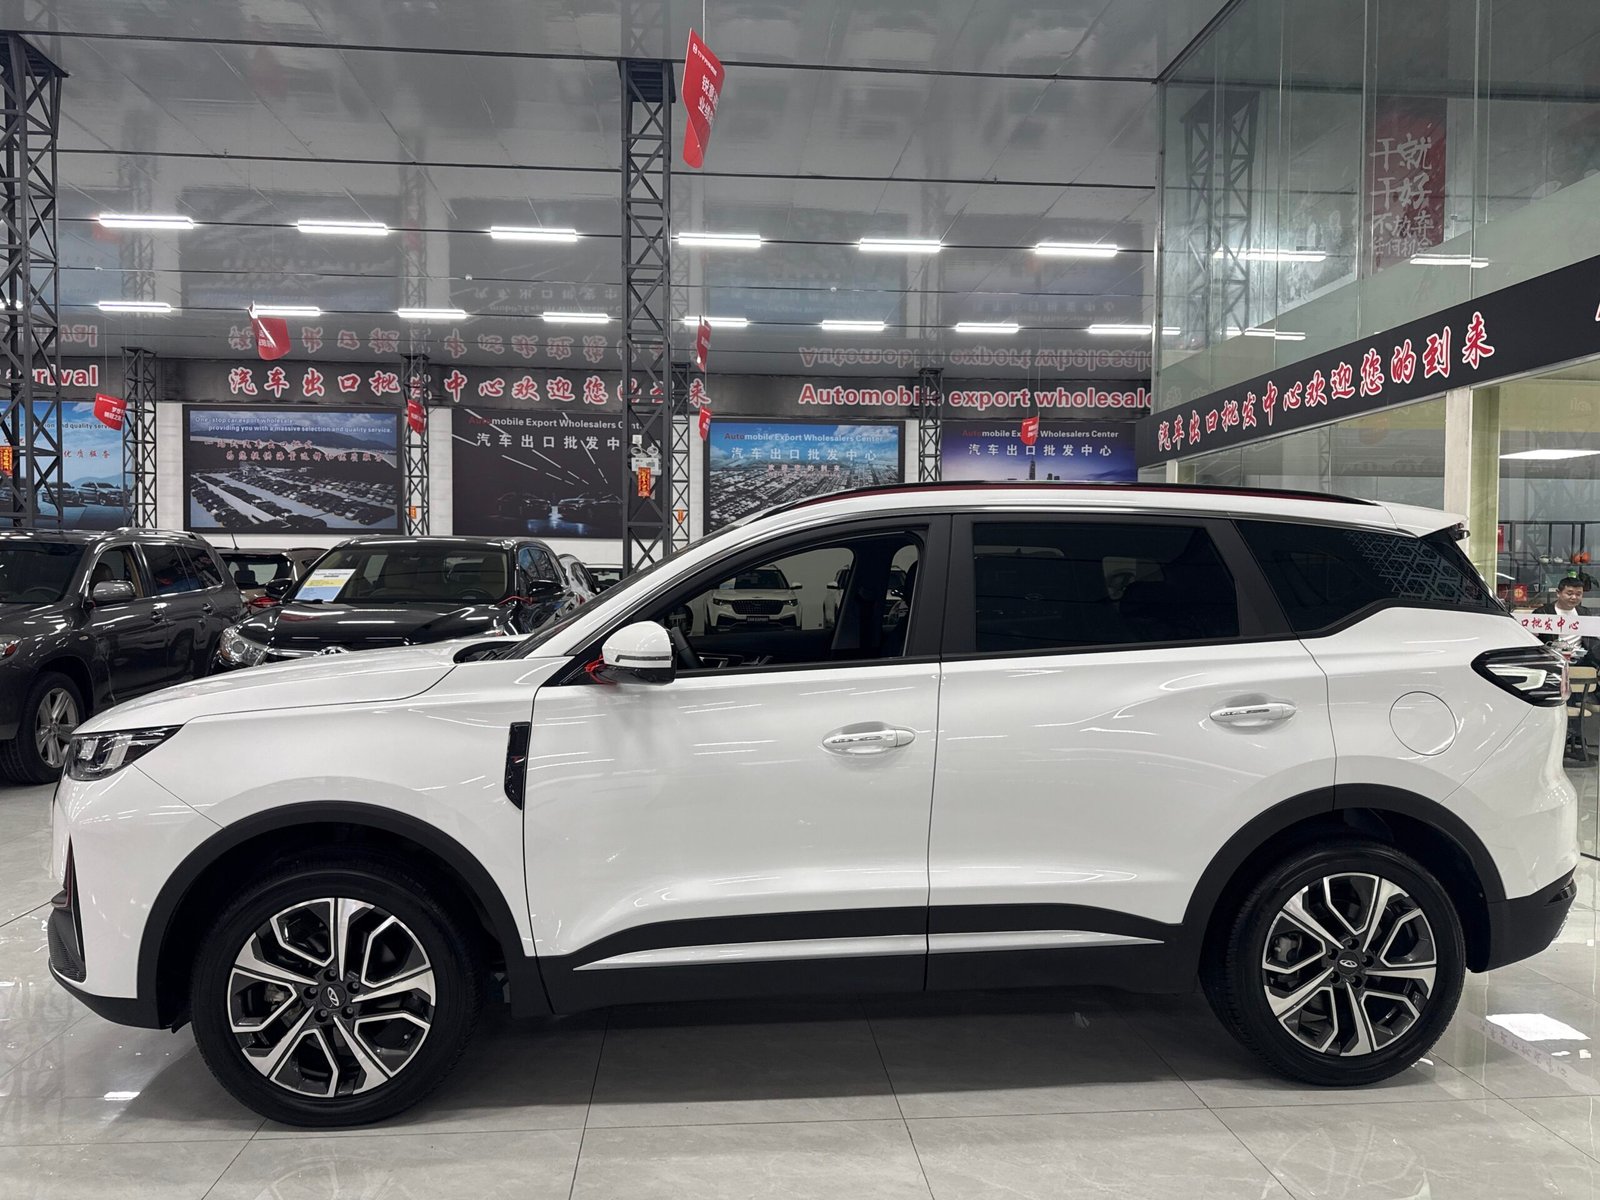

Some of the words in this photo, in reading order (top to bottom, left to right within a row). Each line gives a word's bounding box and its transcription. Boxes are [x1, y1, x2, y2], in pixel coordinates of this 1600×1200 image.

[1158, 311, 1496, 452] 汽车出口批发中心欢迎您的到来
[948, 389, 1030, 411] export
[208, 424, 240, 432] providing
[525, 418, 558, 428] Export
[559, 418, 616, 430] Wholesalers
[724, 432, 773, 441] Automobile
[774, 433, 802, 442] Export
[803, 433, 854, 442] Wholesalers
[855, 433, 884, 442] Center
[962, 429, 1010, 438] Automobile
[1040, 429, 1090, 438] Wholesalers
[1091, 430, 1119, 438] Center
[731, 447, 877, 460] 汽车出口批发中心
[968, 443, 1112, 457] 汽车出口批发中心
[1521, 616, 1580, 633] 口批发中心
